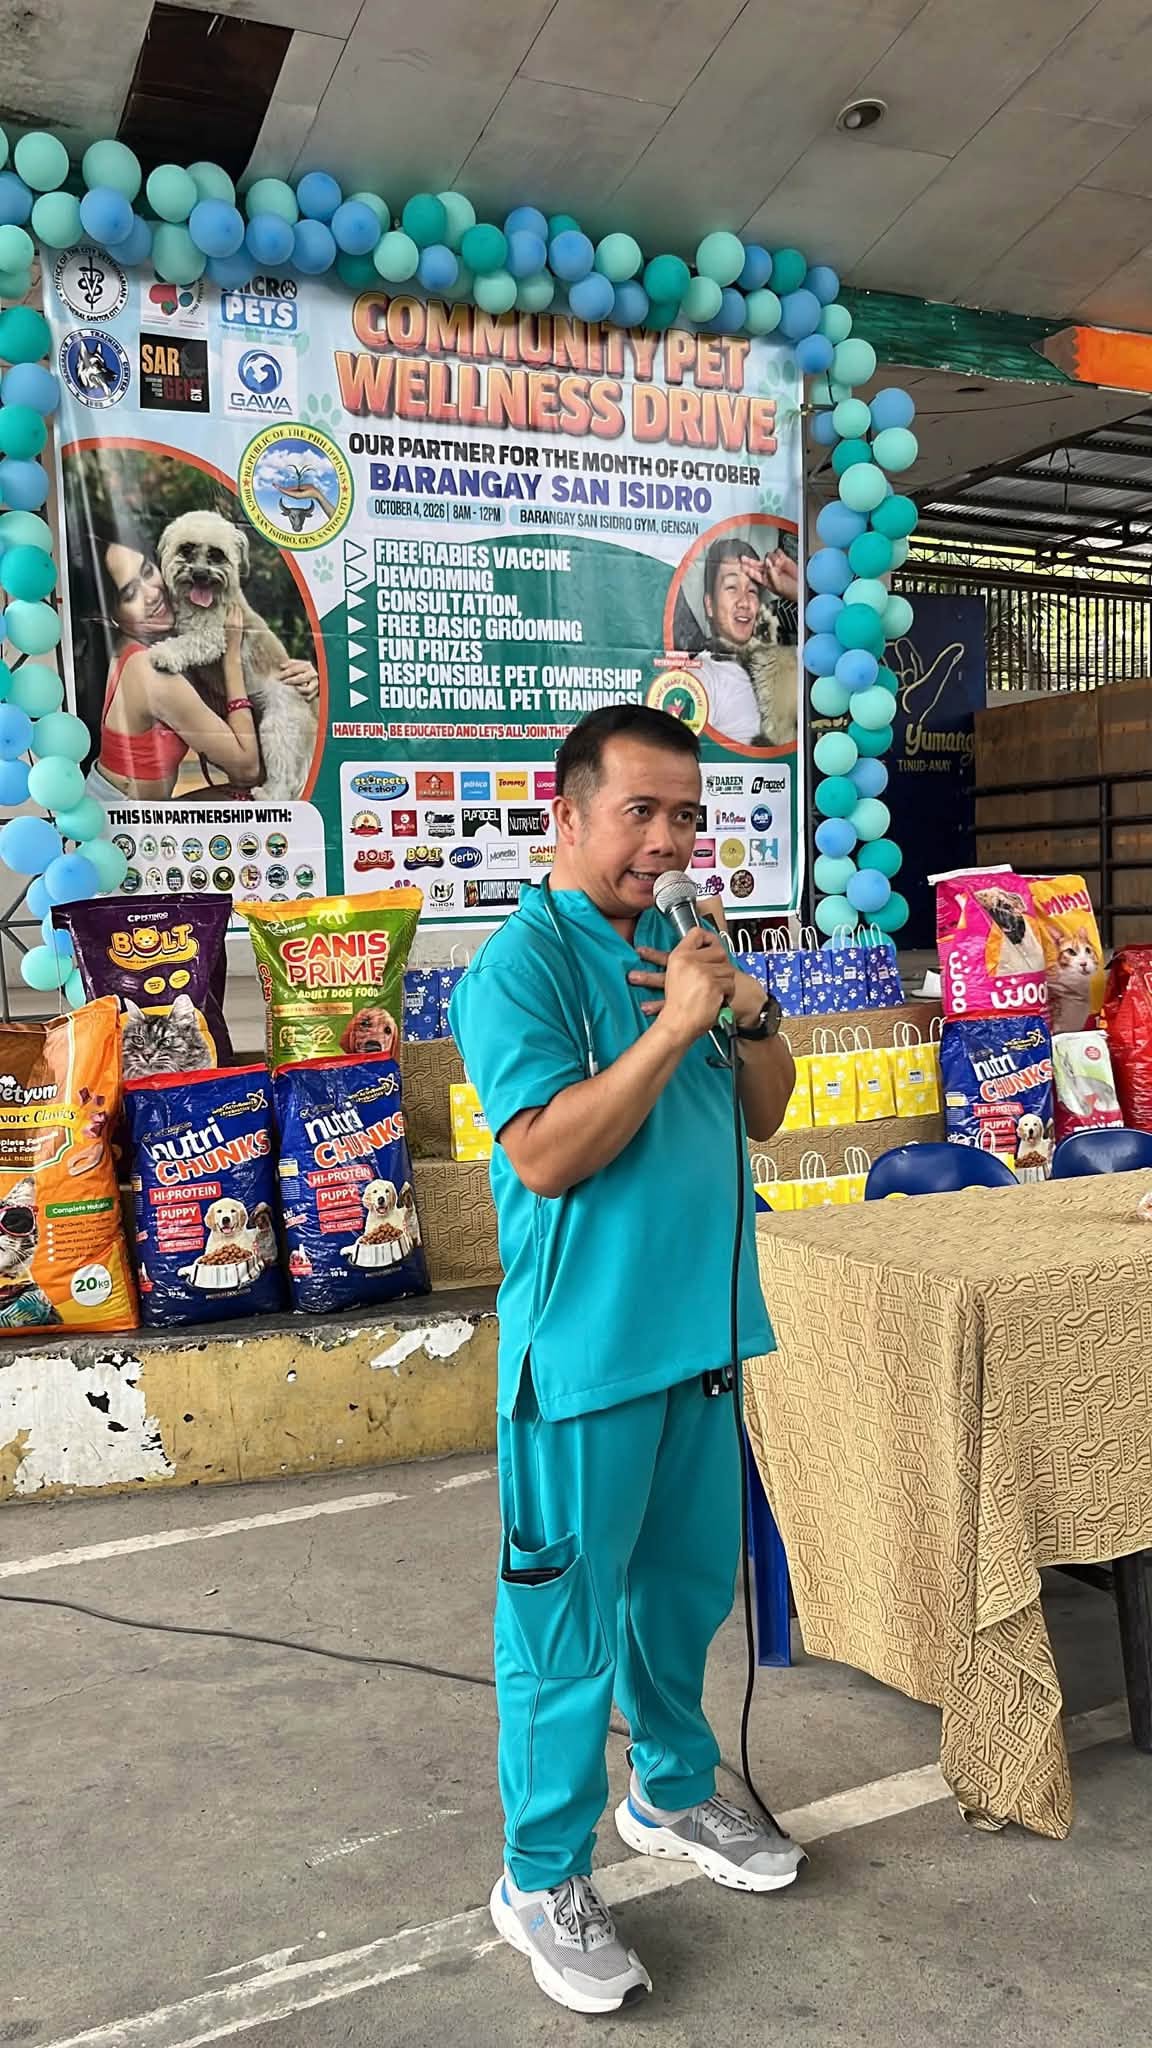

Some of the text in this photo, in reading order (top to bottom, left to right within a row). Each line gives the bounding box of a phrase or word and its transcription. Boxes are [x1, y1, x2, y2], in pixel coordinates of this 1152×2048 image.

[86, 313, 109, 323] SANTOS
[108, 306, 121, 320] CITY
[224, 296, 294, 329] PETS
[90, 330, 124, 356] TRAINING
[352, 292, 751, 390] COMMUNITY PET
[141, 344, 181, 378] SAR
[230, 392, 293, 412] GAWA
[335, 351, 778, 455] WELLNESS DRIVE
[244, 427, 347, 485] REPUBLIC OF THE PHILIPPINES
[349, 433, 761, 486] OUR PARTNER FOR THE MONTH OF OCTOBER
[370, 463, 712, 514] BARANGAY SAN ISIDRO
[255, 511, 270, 531] SAN
[268, 526, 299, 545] ISIDRO,
[318, 515, 344, 539] SANTOS
[338, 496, 349, 519] CITY
[374, 500, 410, 519] OCTOBER
[410, 502, 420, 521] 4,
[421, 503, 446, 520] 2026
[452, 504, 471, 521] 8AM
[479, 505, 502, 522] 12PM
[520, 507, 700, 536] BARANGAY SAN ISIDRO GYM, GENSAN
[375, 539, 571, 573] FREE RABIES VACCINE
[376, 564, 494, 593] DEWORMING
[377, 589, 523, 619] CONSULTATION,
[377, 613, 583, 643] FREE BASIC GROOMING
[378, 637, 483, 663] FUN PRIZES
[379, 661, 642, 691] RESPONSIBLE PET OWNERSHIP
[379, 685, 506, 711] EDUCATIONAL
[507, 687, 543, 712] PET
[334, 723, 363, 738] HAVE
[363, 724, 388, 740] FUN,
[390, 725, 404, 738] BE
[404, 724, 455, 738] EDUCATED
[456, 724, 478, 738] AND
[479, 724, 505, 739] LET'S
[505, 725, 523, 739] ALL
[525, 725, 549, 738] JOIN
[498, 778, 526, 788] Tommy
[715, 775, 743, 786] DAREEN
[107, 808, 293, 825] THIS IS IN PARTNERSHIP WITH:
[357, 849, 393, 861] BOLT
[406, 846, 442, 862] BOLT
[450, 850, 480, 864] derby
[111, 923, 194, 958] BOLT
[280, 930, 390, 963] CANIS
[286, 956, 388, 989] PRIME
[297, 986, 379, 1000] ADULT DOG FOOD
[972, 1047, 1017, 1082] nutri
[980, 1058, 1054, 1103] CHUNKS
[34, 1110, 76, 1123] Classics
[304, 1101, 364, 1144] nutri
[983, 1118, 1013, 1130] PUPPY
[1, 1145, 18, 1153] Cat
[151, 1116, 225, 1162] nutri
[314, 1111, 405, 1169] CHUNKS
[155, 1129, 272, 1187] CHUNKS
[312, 1167, 371, 1185] HI-PROTEIN
[154, 1185, 217, 1202] HI-PROTEIN
[321, 1188, 356, 1202] PUPPY
[52, 1205, 86, 1215] Complete
[161, 1207, 198, 1220] PUPPY
[74, 1277, 111, 1293] 20 kg
